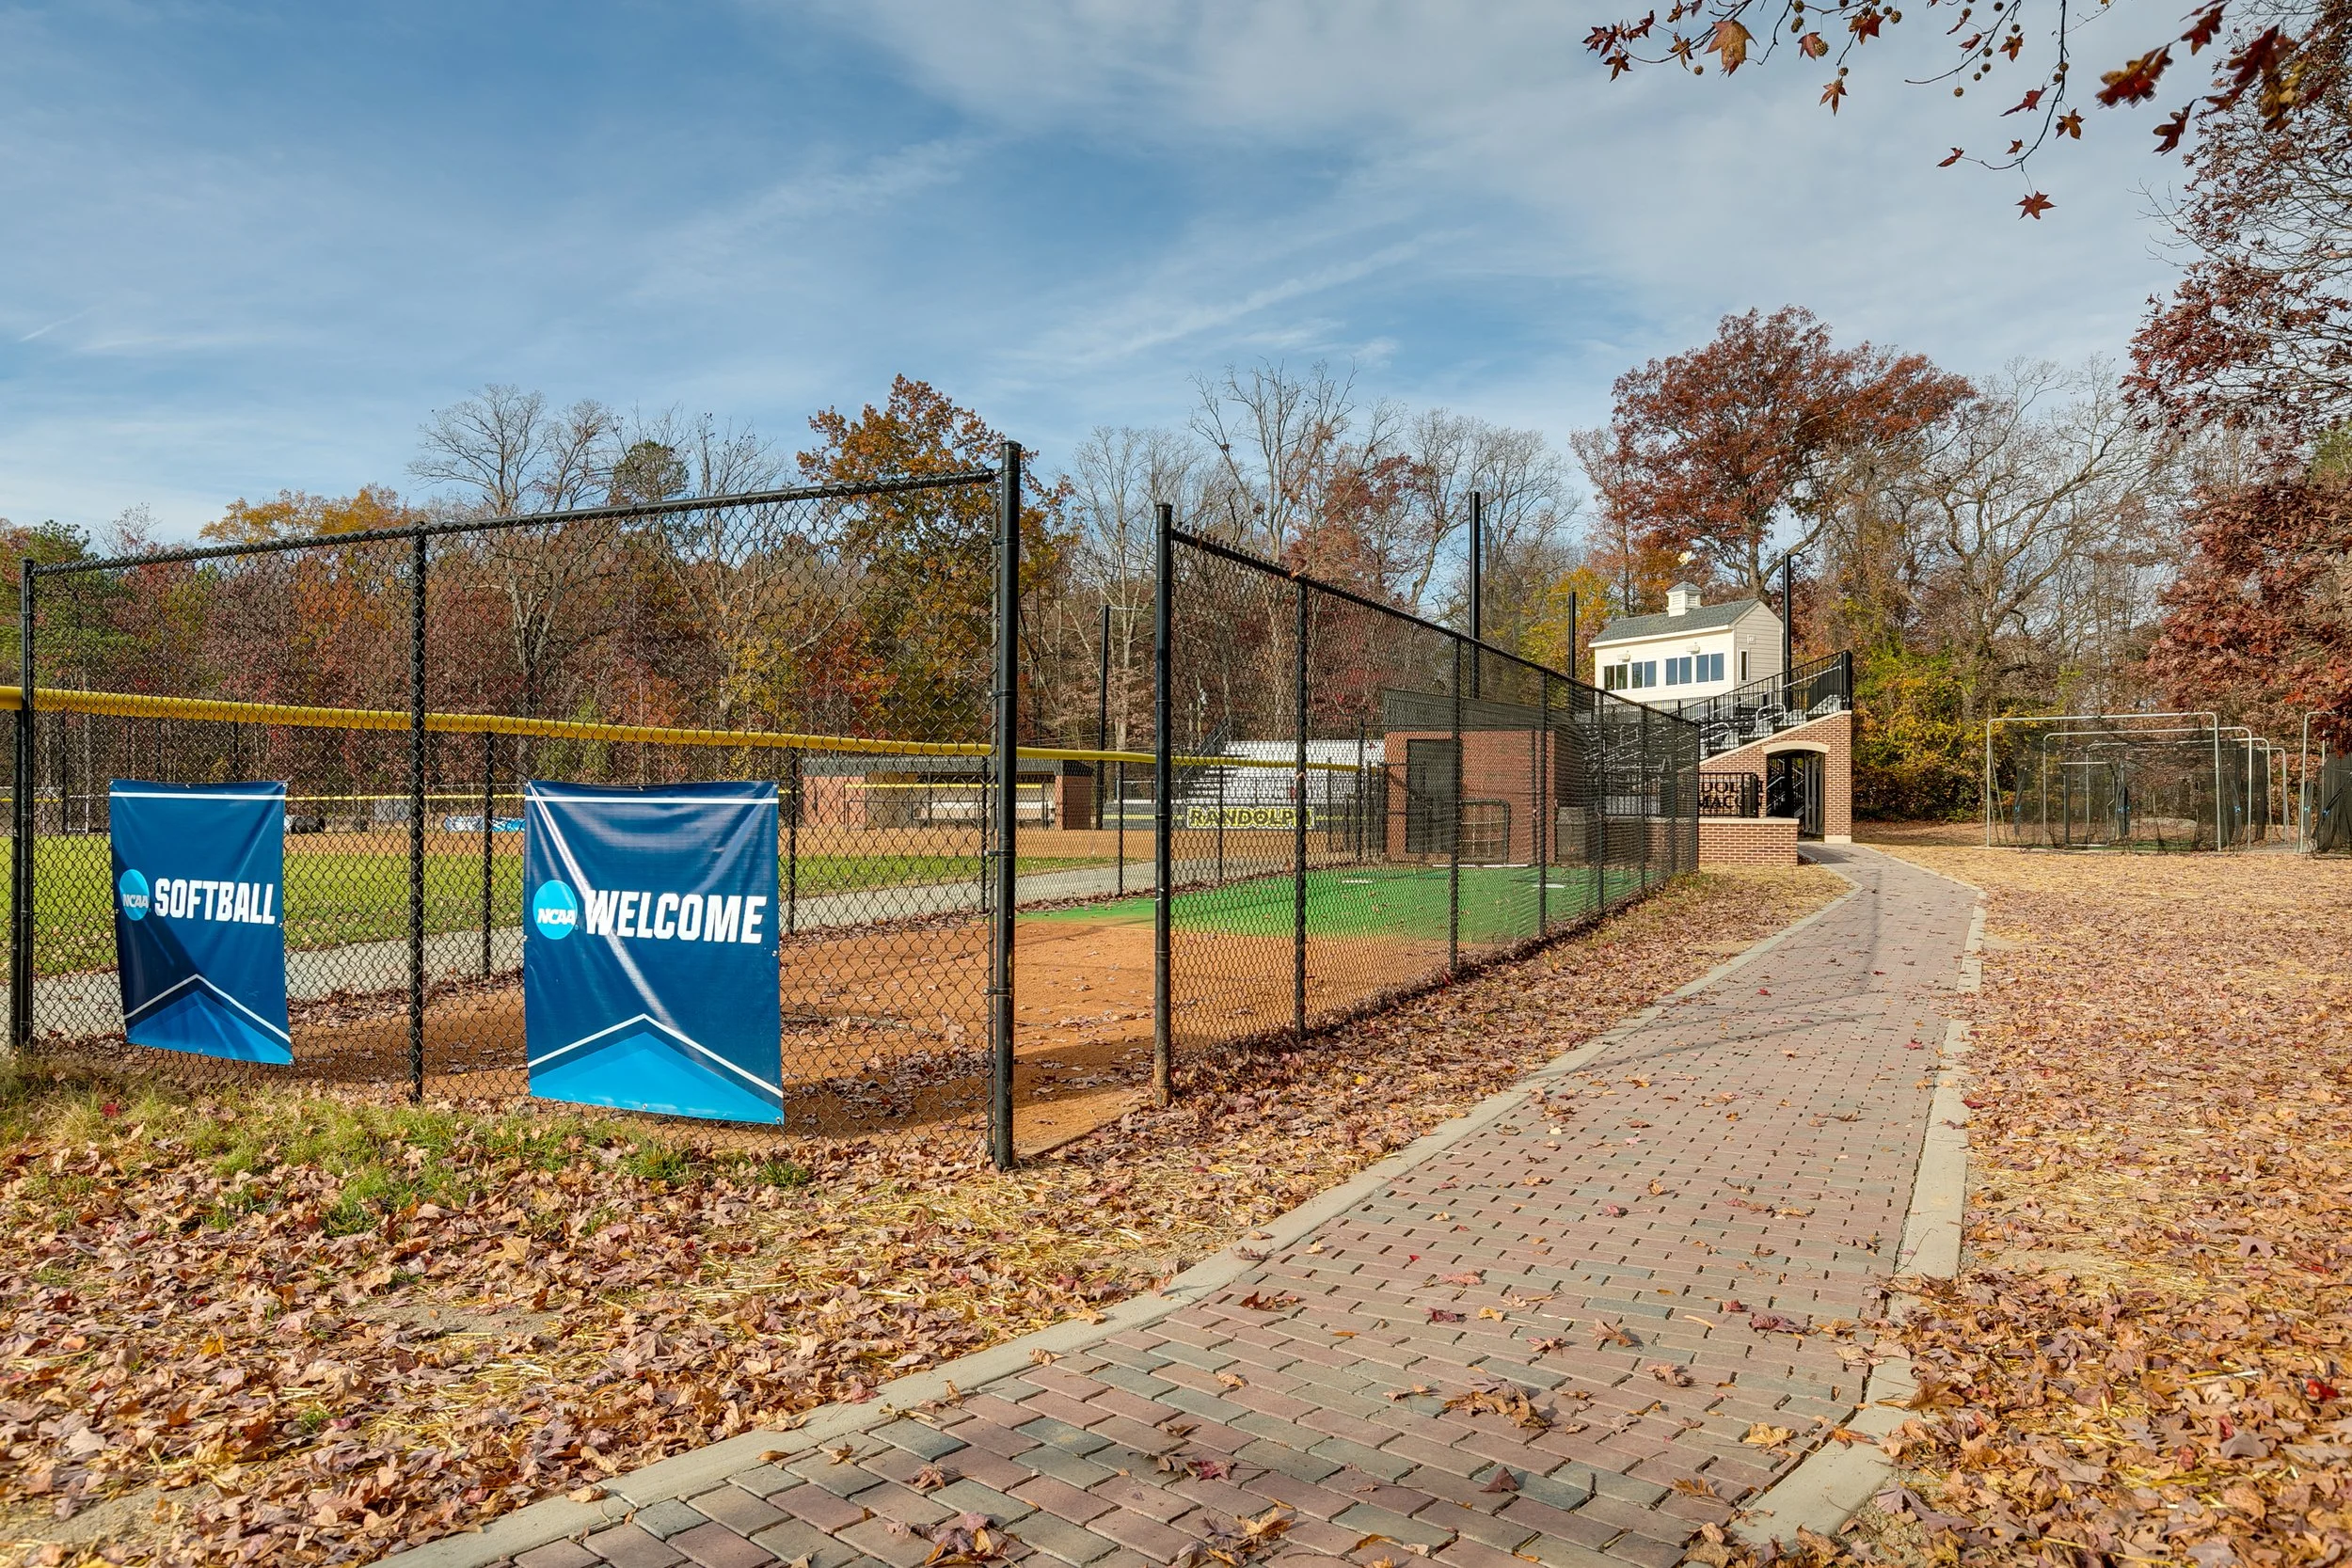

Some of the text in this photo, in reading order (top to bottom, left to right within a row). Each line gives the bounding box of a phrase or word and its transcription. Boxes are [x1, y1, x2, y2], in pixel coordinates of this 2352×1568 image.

[122, 878, 276, 925] NCAA SOFTBALL
[537, 890, 767, 943] NCAA WELCOME
